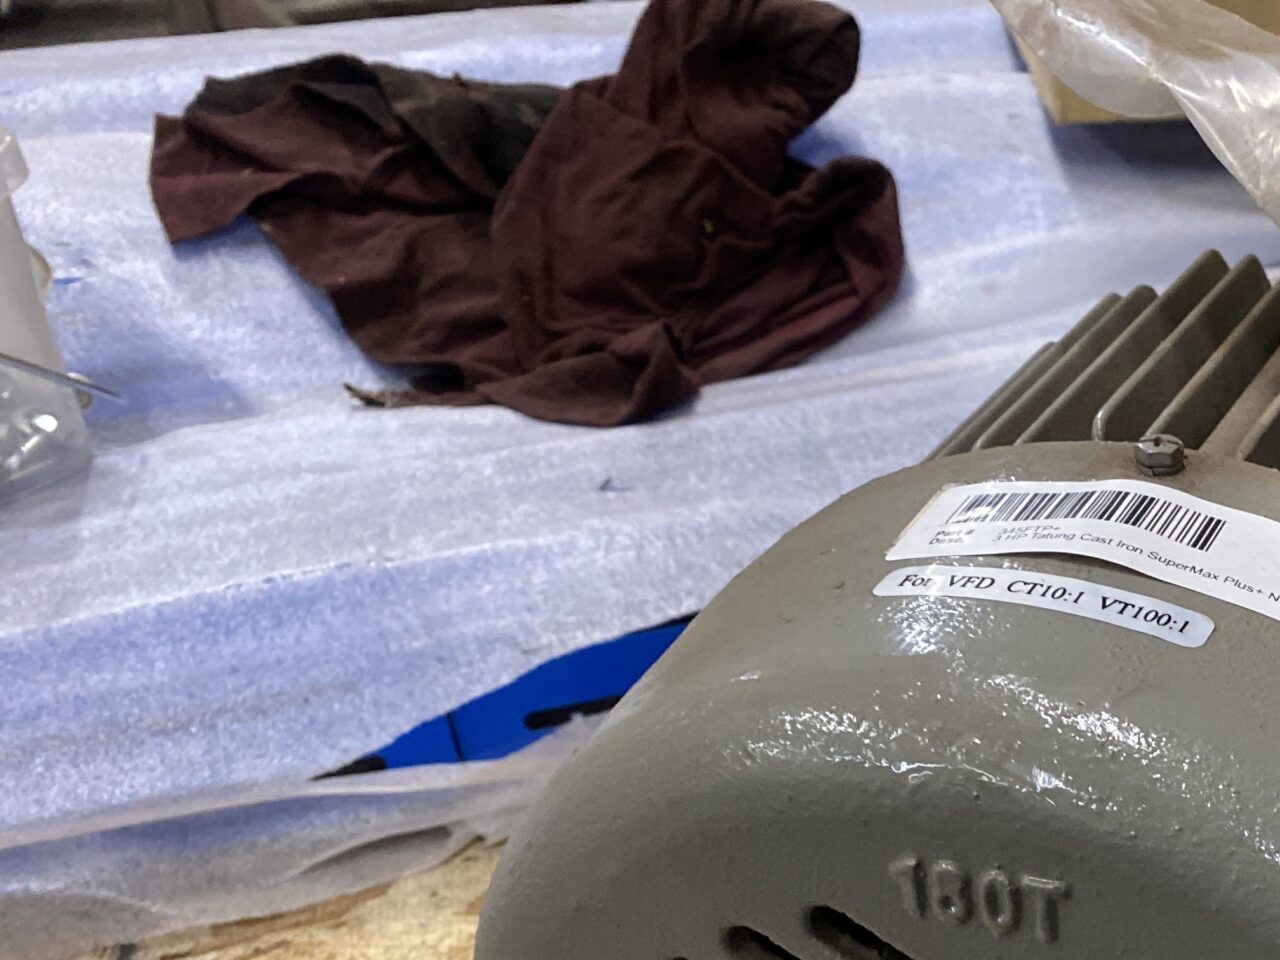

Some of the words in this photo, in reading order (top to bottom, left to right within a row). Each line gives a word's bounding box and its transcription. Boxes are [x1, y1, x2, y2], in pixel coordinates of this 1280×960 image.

[1004, 533, 1028, 541] HP
[1031, 532, 1076, 541] Tatung
[1080, 533, 1113, 546] Cast
[1116, 540, 1144, 554] Iron
[1147, 551, 1220, 581] SuperMax
[1223, 575, 1264, 595] Plus+
[898, 574, 935, 588] For
[949, 575, 996, 590] VFD
[1007, 580, 1085, 605] CT10:1
[1100, 596, 1190, 634] VT100:1
